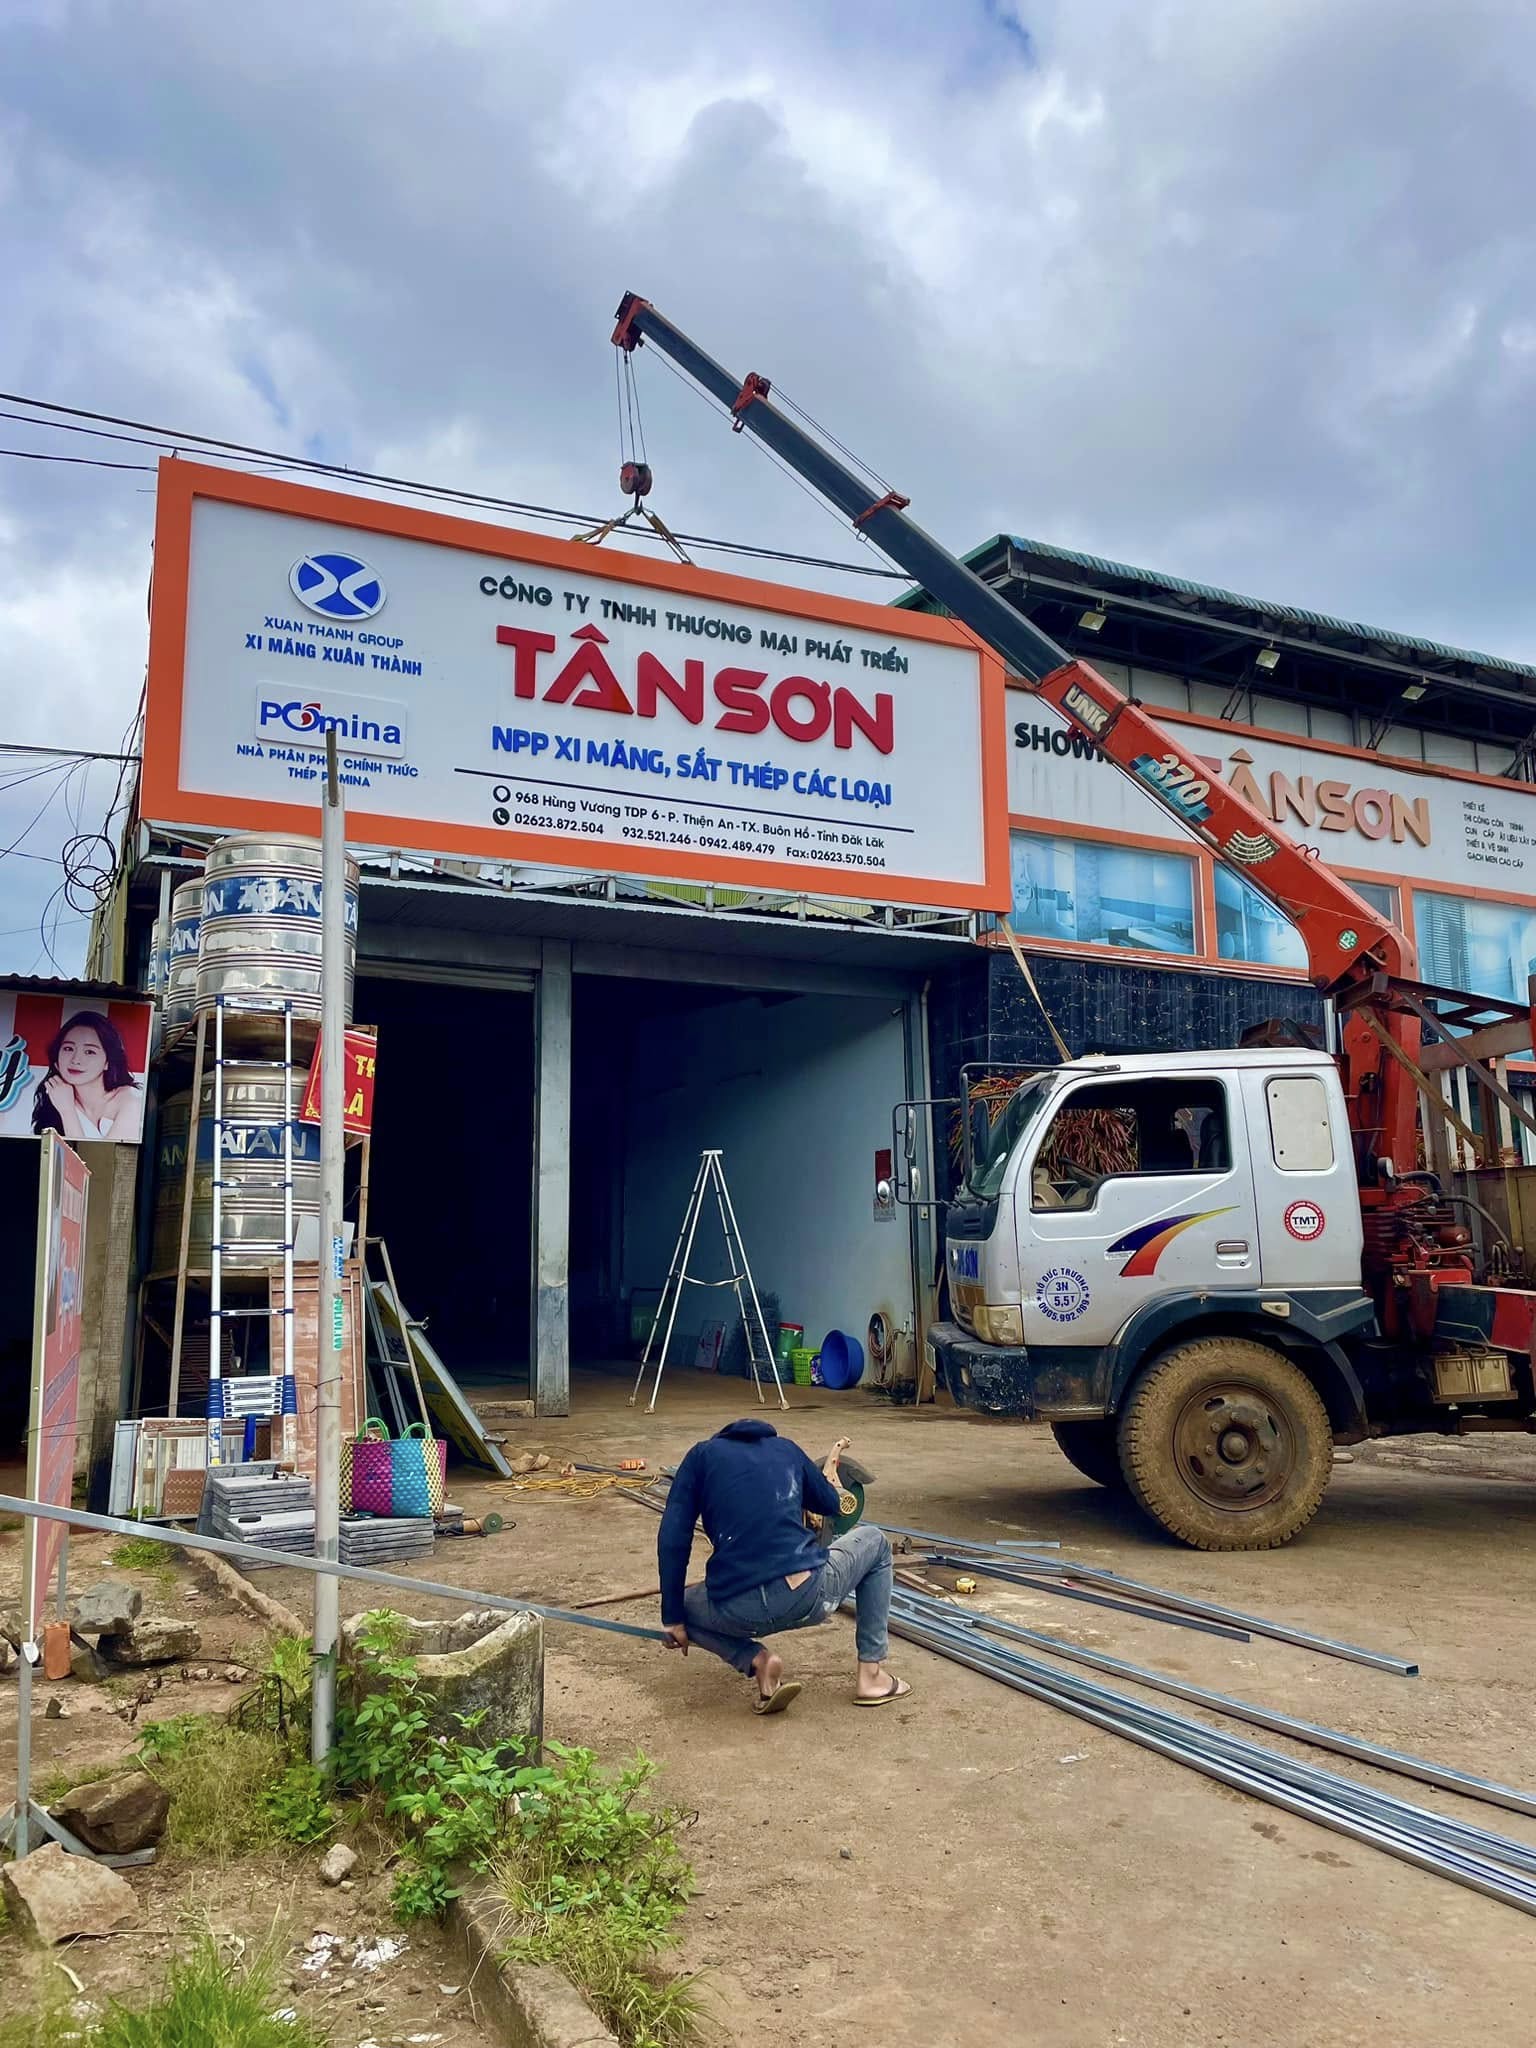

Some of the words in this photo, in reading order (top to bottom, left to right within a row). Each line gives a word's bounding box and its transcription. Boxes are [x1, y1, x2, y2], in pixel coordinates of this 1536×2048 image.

[264, 616, 303, 633] XUAN
[307, 623, 354, 641] THANH
[358, 632, 404, 649] GROUP
[480, 575, 552, 606] CÔNG
[564, 591, 590, 614] TY
[600, 598, 656, 627] TNHH
[666, 611, 752, 644] THƯƠNG
[760, 629, 797, 656] MẠI
[806, 639, 852, 664] PHÁT
[245, 633, 262, 650] XI
[268, 637, 317, 659] MĂNG
[322, 646, 365, 667] XUÂN
[371, 654, 422, 676] THÀNH
[237, 743, 264, 758] NHÀ
[269, 747, 305, 763] PHÂN
[309, 753, 339, 767] PHI
[343, 757, 382, 774] CHÍNH
[386, 763, 419, 778] THỨC
[288, 765, 317, 781] THÉP
[321, 771, 371, 787] PMINA
[492, 725, 549, 756] NPP
[554, 735, 581, 762] XI
[587, 739, 671, 778] MĂNG,
[677, 747, 722, 782] SẮT
[727, 761, 789, 791] THÉP
[793, 768, 837, 798] CÁC
[841, 778, 892, 809] LOẠI
[514, 813, 604, 835] 02623.872.504
[515, 791, 539, 805] 968
[542, 795, 576, 812] Hùng
[580, 800, 621, 818] Vương
[624, 806, 647, 820] TDP
[763, 824, 791, 838] Buôn
[1292, 1216, 1317, 1225] TMT
[1056, 1282, 1069, 1291] 3N
